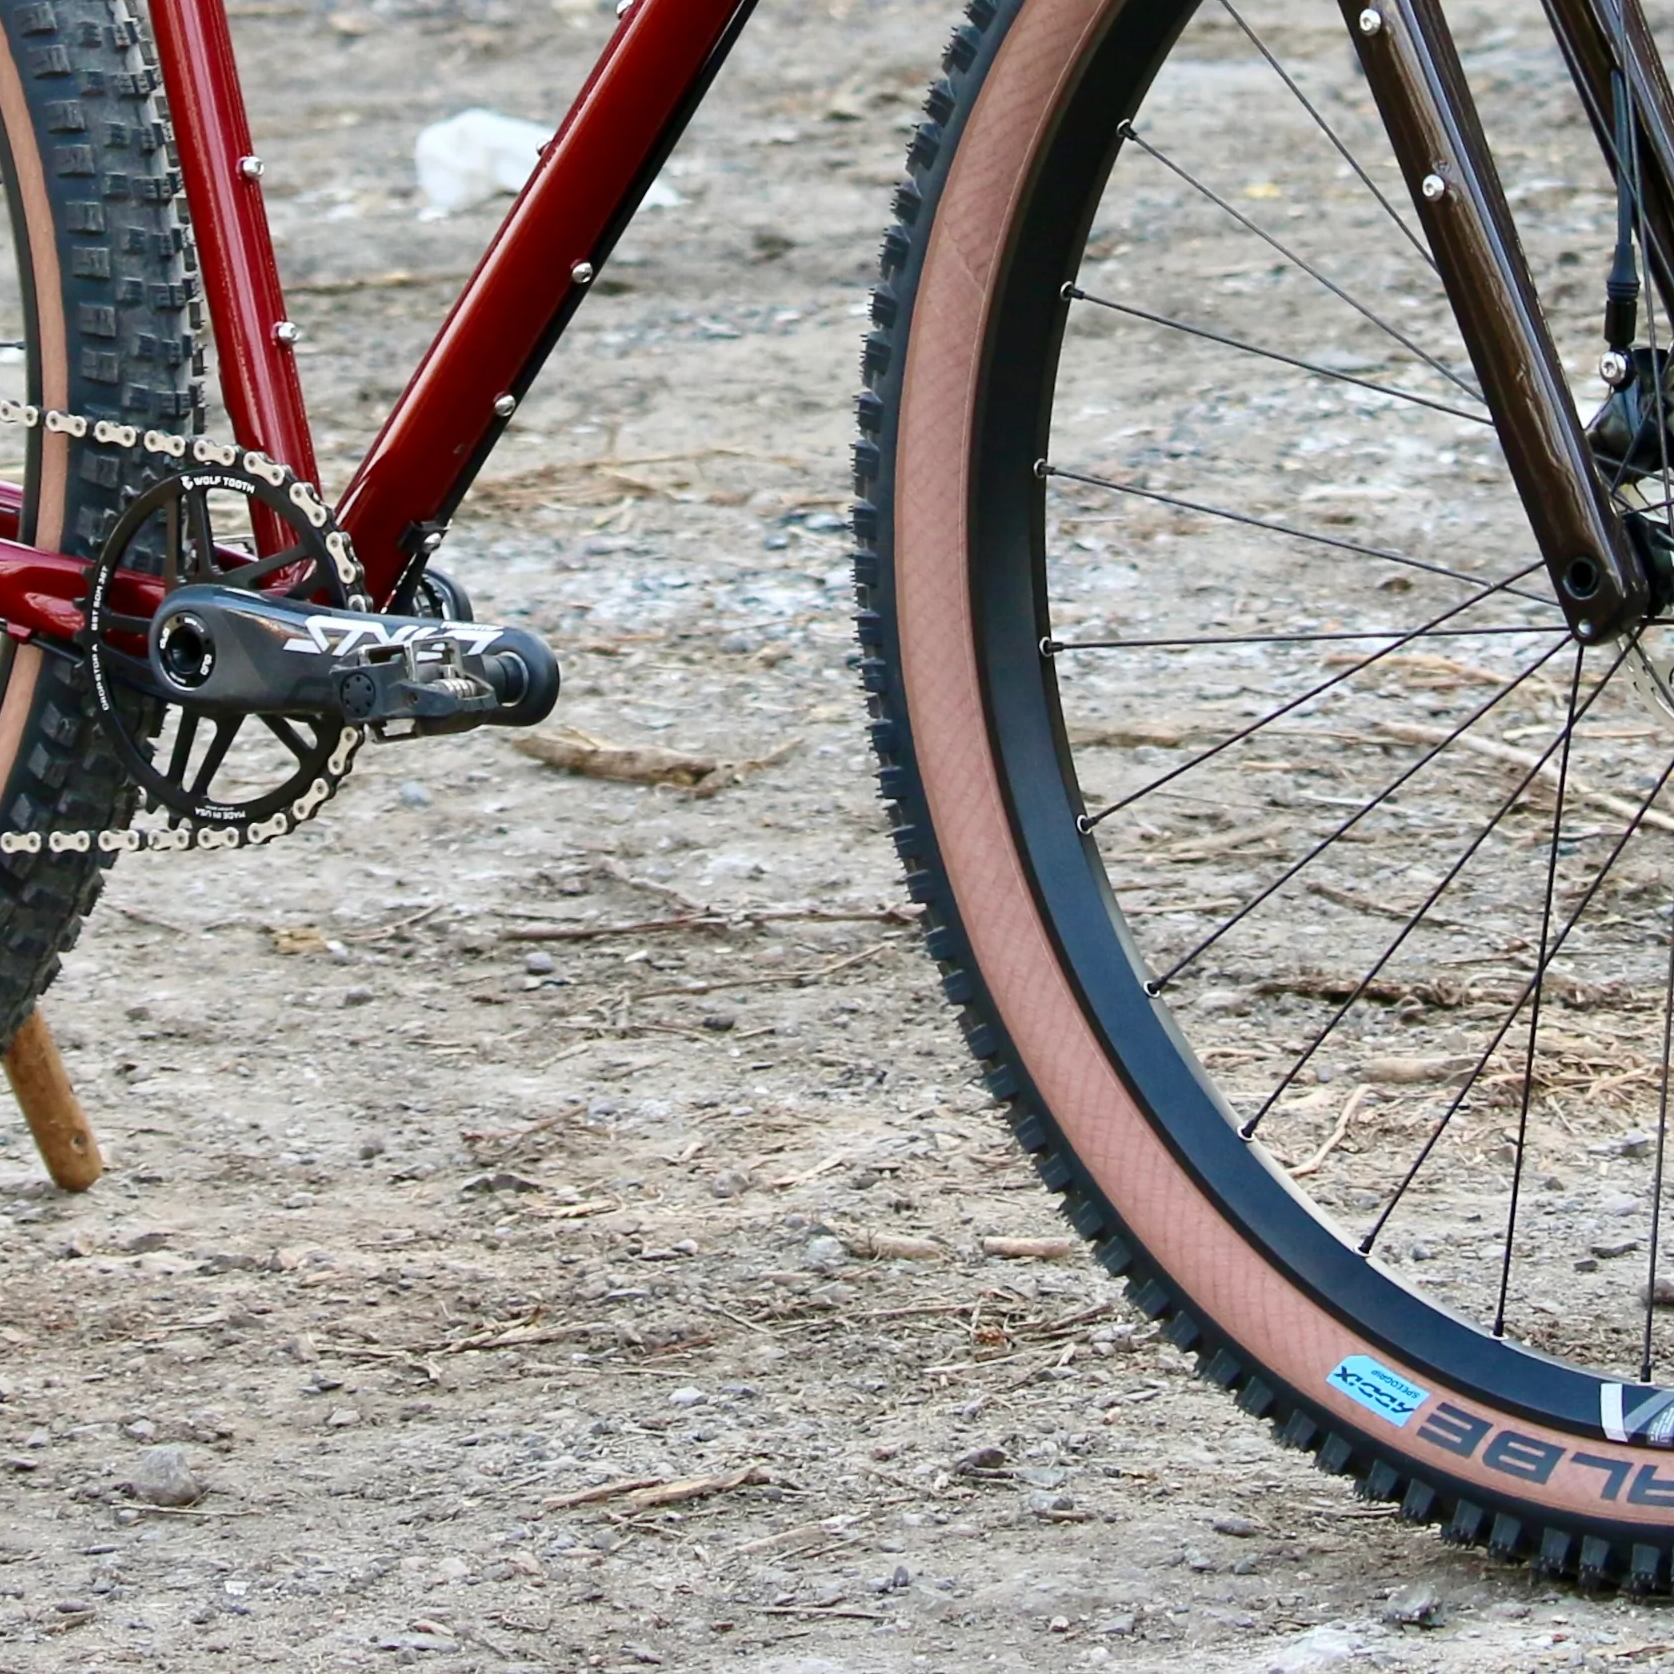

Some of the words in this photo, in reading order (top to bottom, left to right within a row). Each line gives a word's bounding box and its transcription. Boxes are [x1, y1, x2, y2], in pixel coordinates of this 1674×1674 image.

[194, 476, 222, 486] WOLF
[223, 476, 256, 494] TOOTH
[194, 806, 212, 818] USA
[222, 810, 247, 820] MADE
